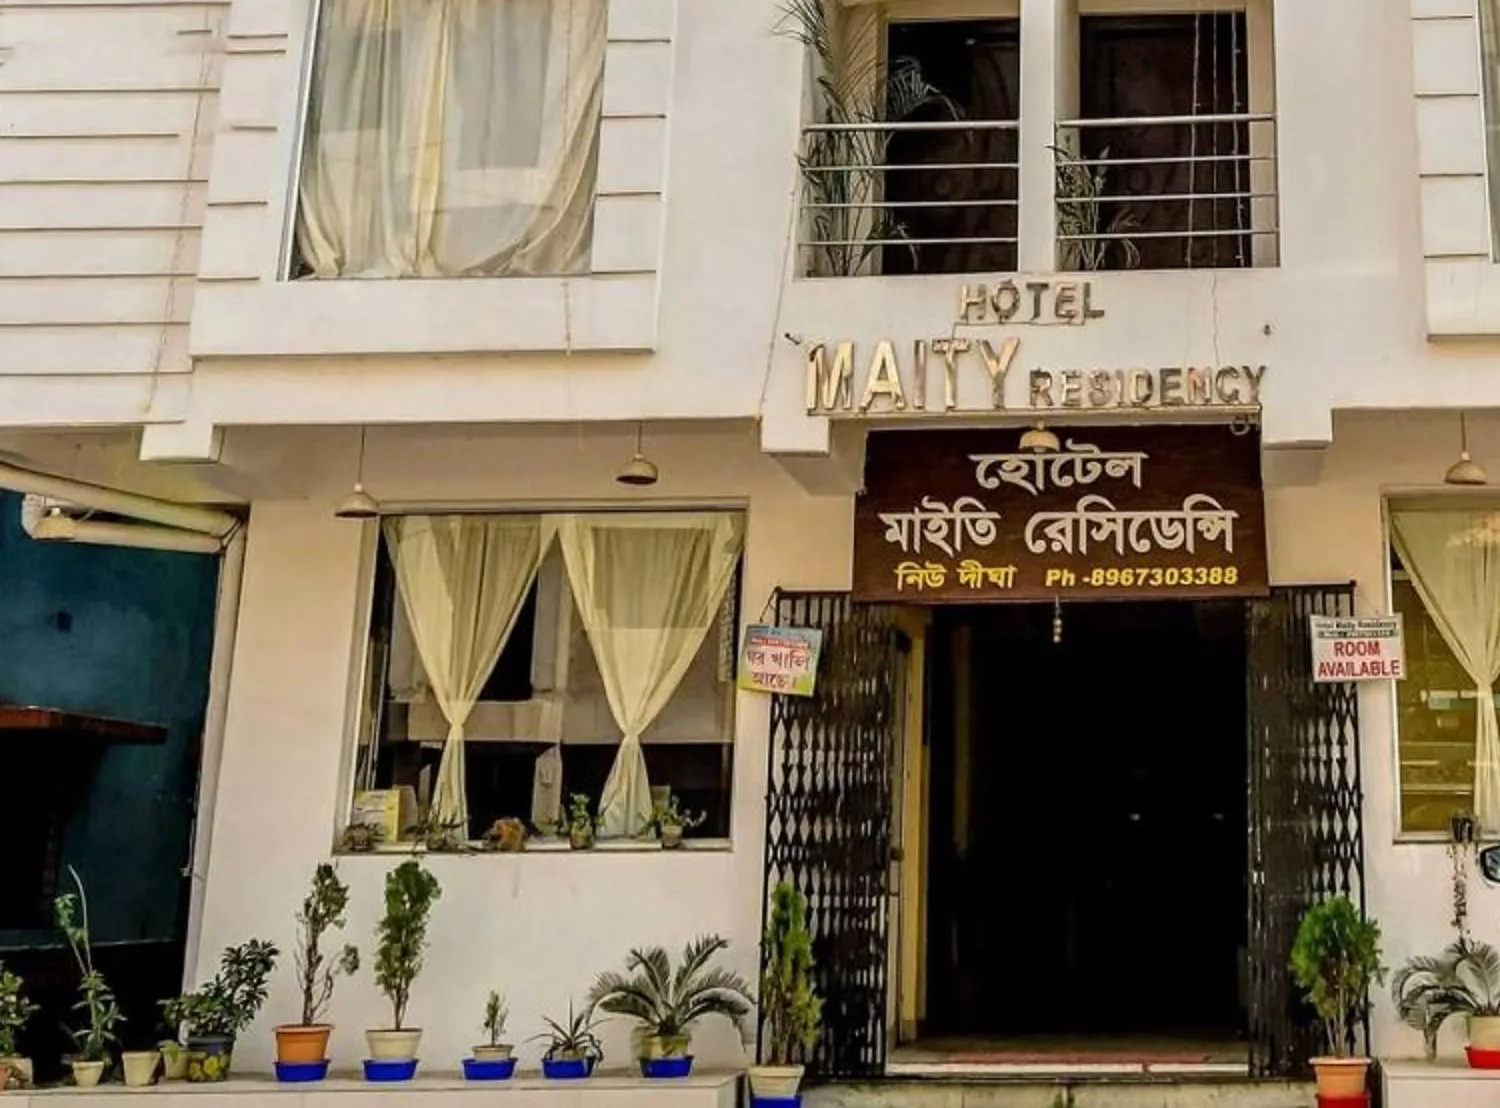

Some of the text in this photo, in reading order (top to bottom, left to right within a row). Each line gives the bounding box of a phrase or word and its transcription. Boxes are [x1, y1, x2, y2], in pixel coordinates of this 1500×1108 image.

[958, 280, 1105, 321] HOTEL
[806, 336, 1267, 410] MAITY RESIDENCY
[968, 439, 1150, 495] হোটেল
[878, 494, 1239, 556] মাইতি রেসিডেন্সি
[894, 562, 947, 591] নিউ
[1045, 570, 1076, 587] Ph
[1334, 640, 1381, 657] ROOM
[1318, 659, 1400, 677] AVAILABLE
